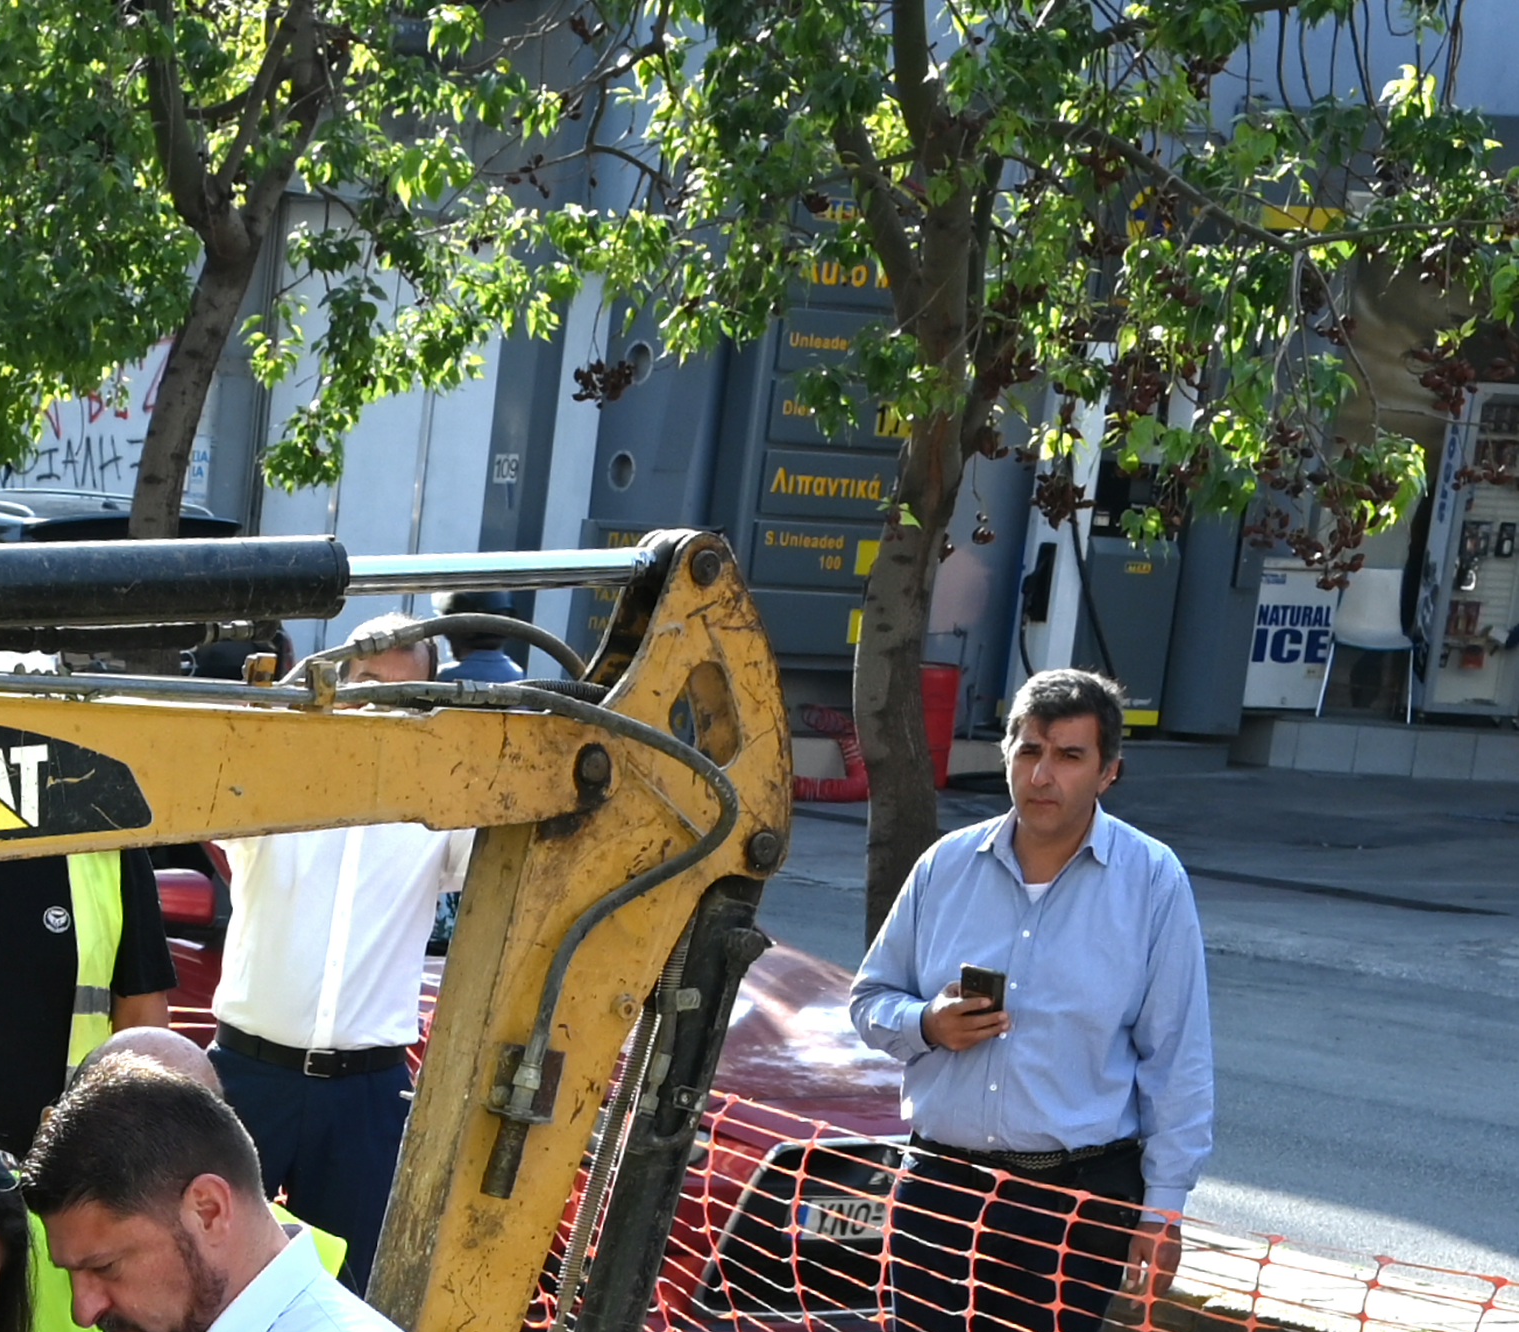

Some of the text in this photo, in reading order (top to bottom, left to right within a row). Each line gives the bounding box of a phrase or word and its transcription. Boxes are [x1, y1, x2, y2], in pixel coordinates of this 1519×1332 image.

[789, 331, 851, 351] Unleade
[495, 457, 519, 479] 109
[769, 466, 882, 500] Λιπαντικά
[819, 555, 842, 571] 100
[1257, 604, 1331, 628] NATURAL
[1251, 628, 1330, 664] ICE
